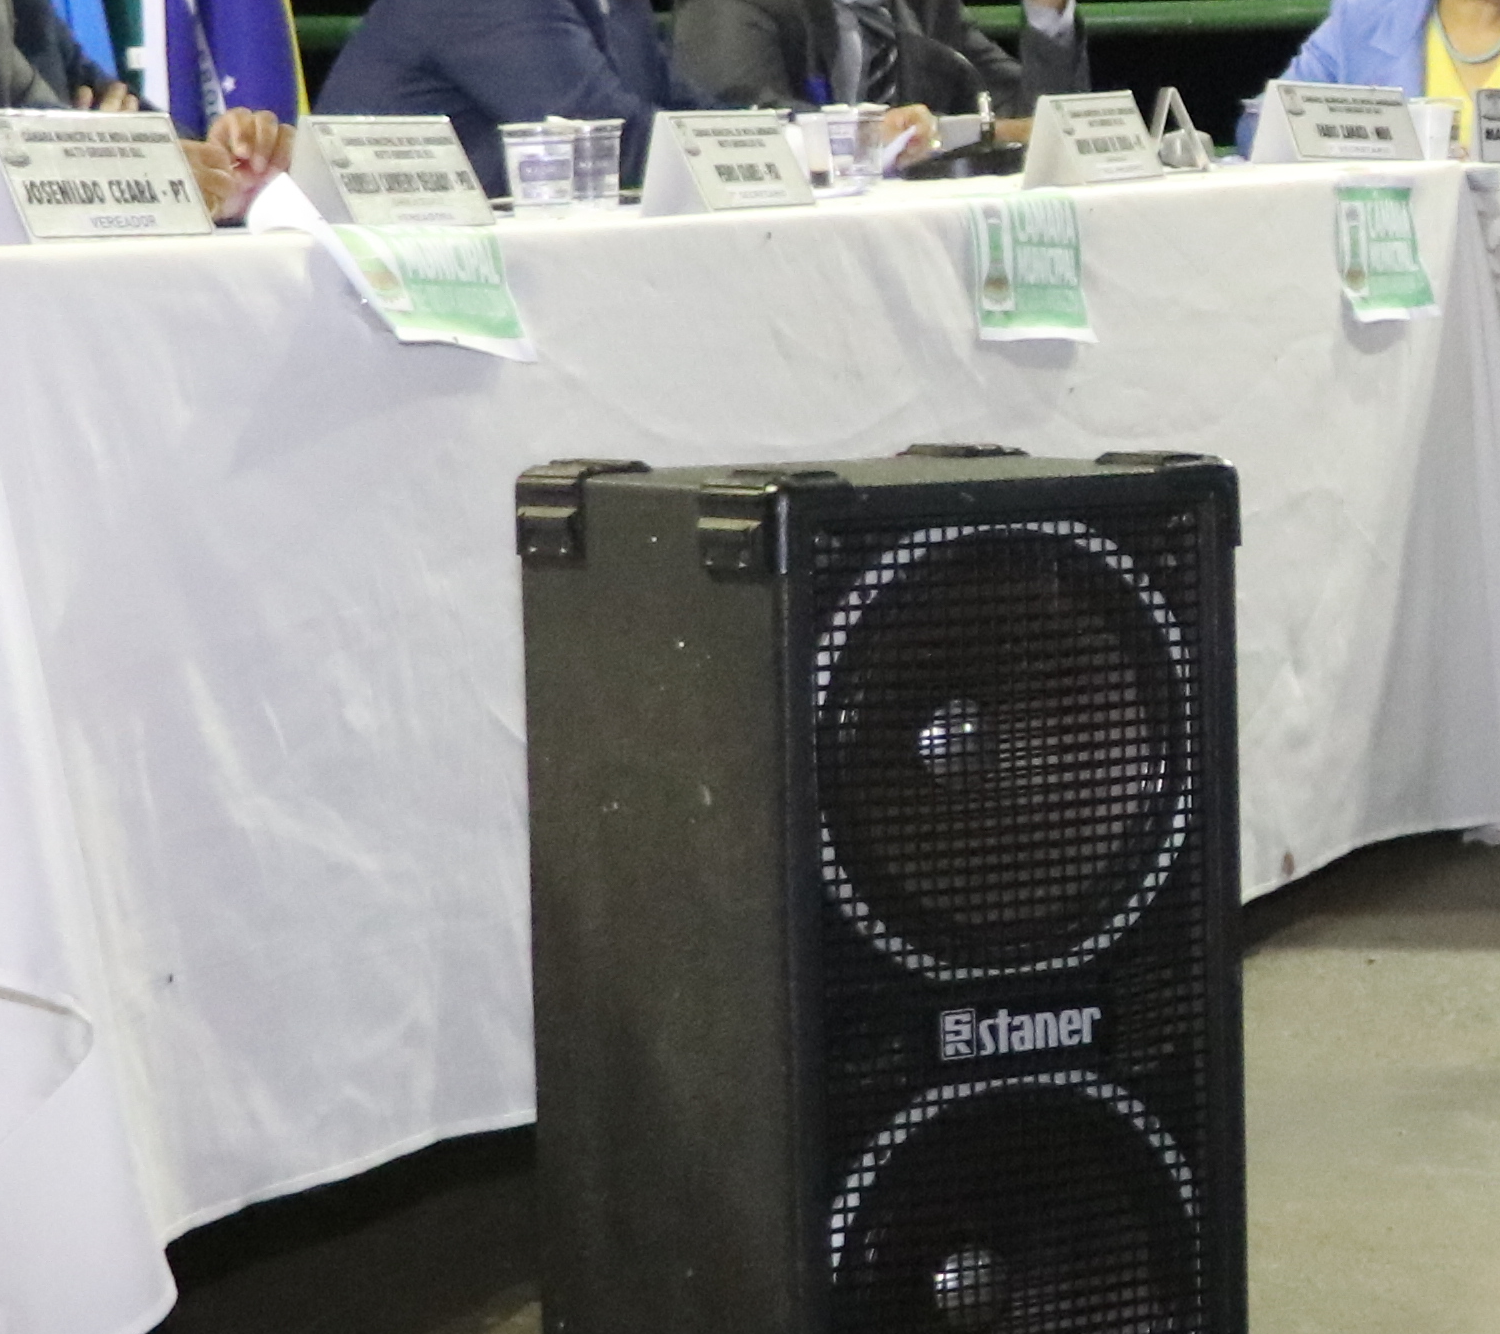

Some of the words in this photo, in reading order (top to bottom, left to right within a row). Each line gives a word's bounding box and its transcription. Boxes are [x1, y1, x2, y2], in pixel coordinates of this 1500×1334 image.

[23, 180, 105, 205] JOSENILDO
[108, 173, 160, 204] CEARÁ
[168, 178, 191, 204] PT
[90, 215, 158, 228] VEREADOR
[979, 1007, 1102, 1056] staner
